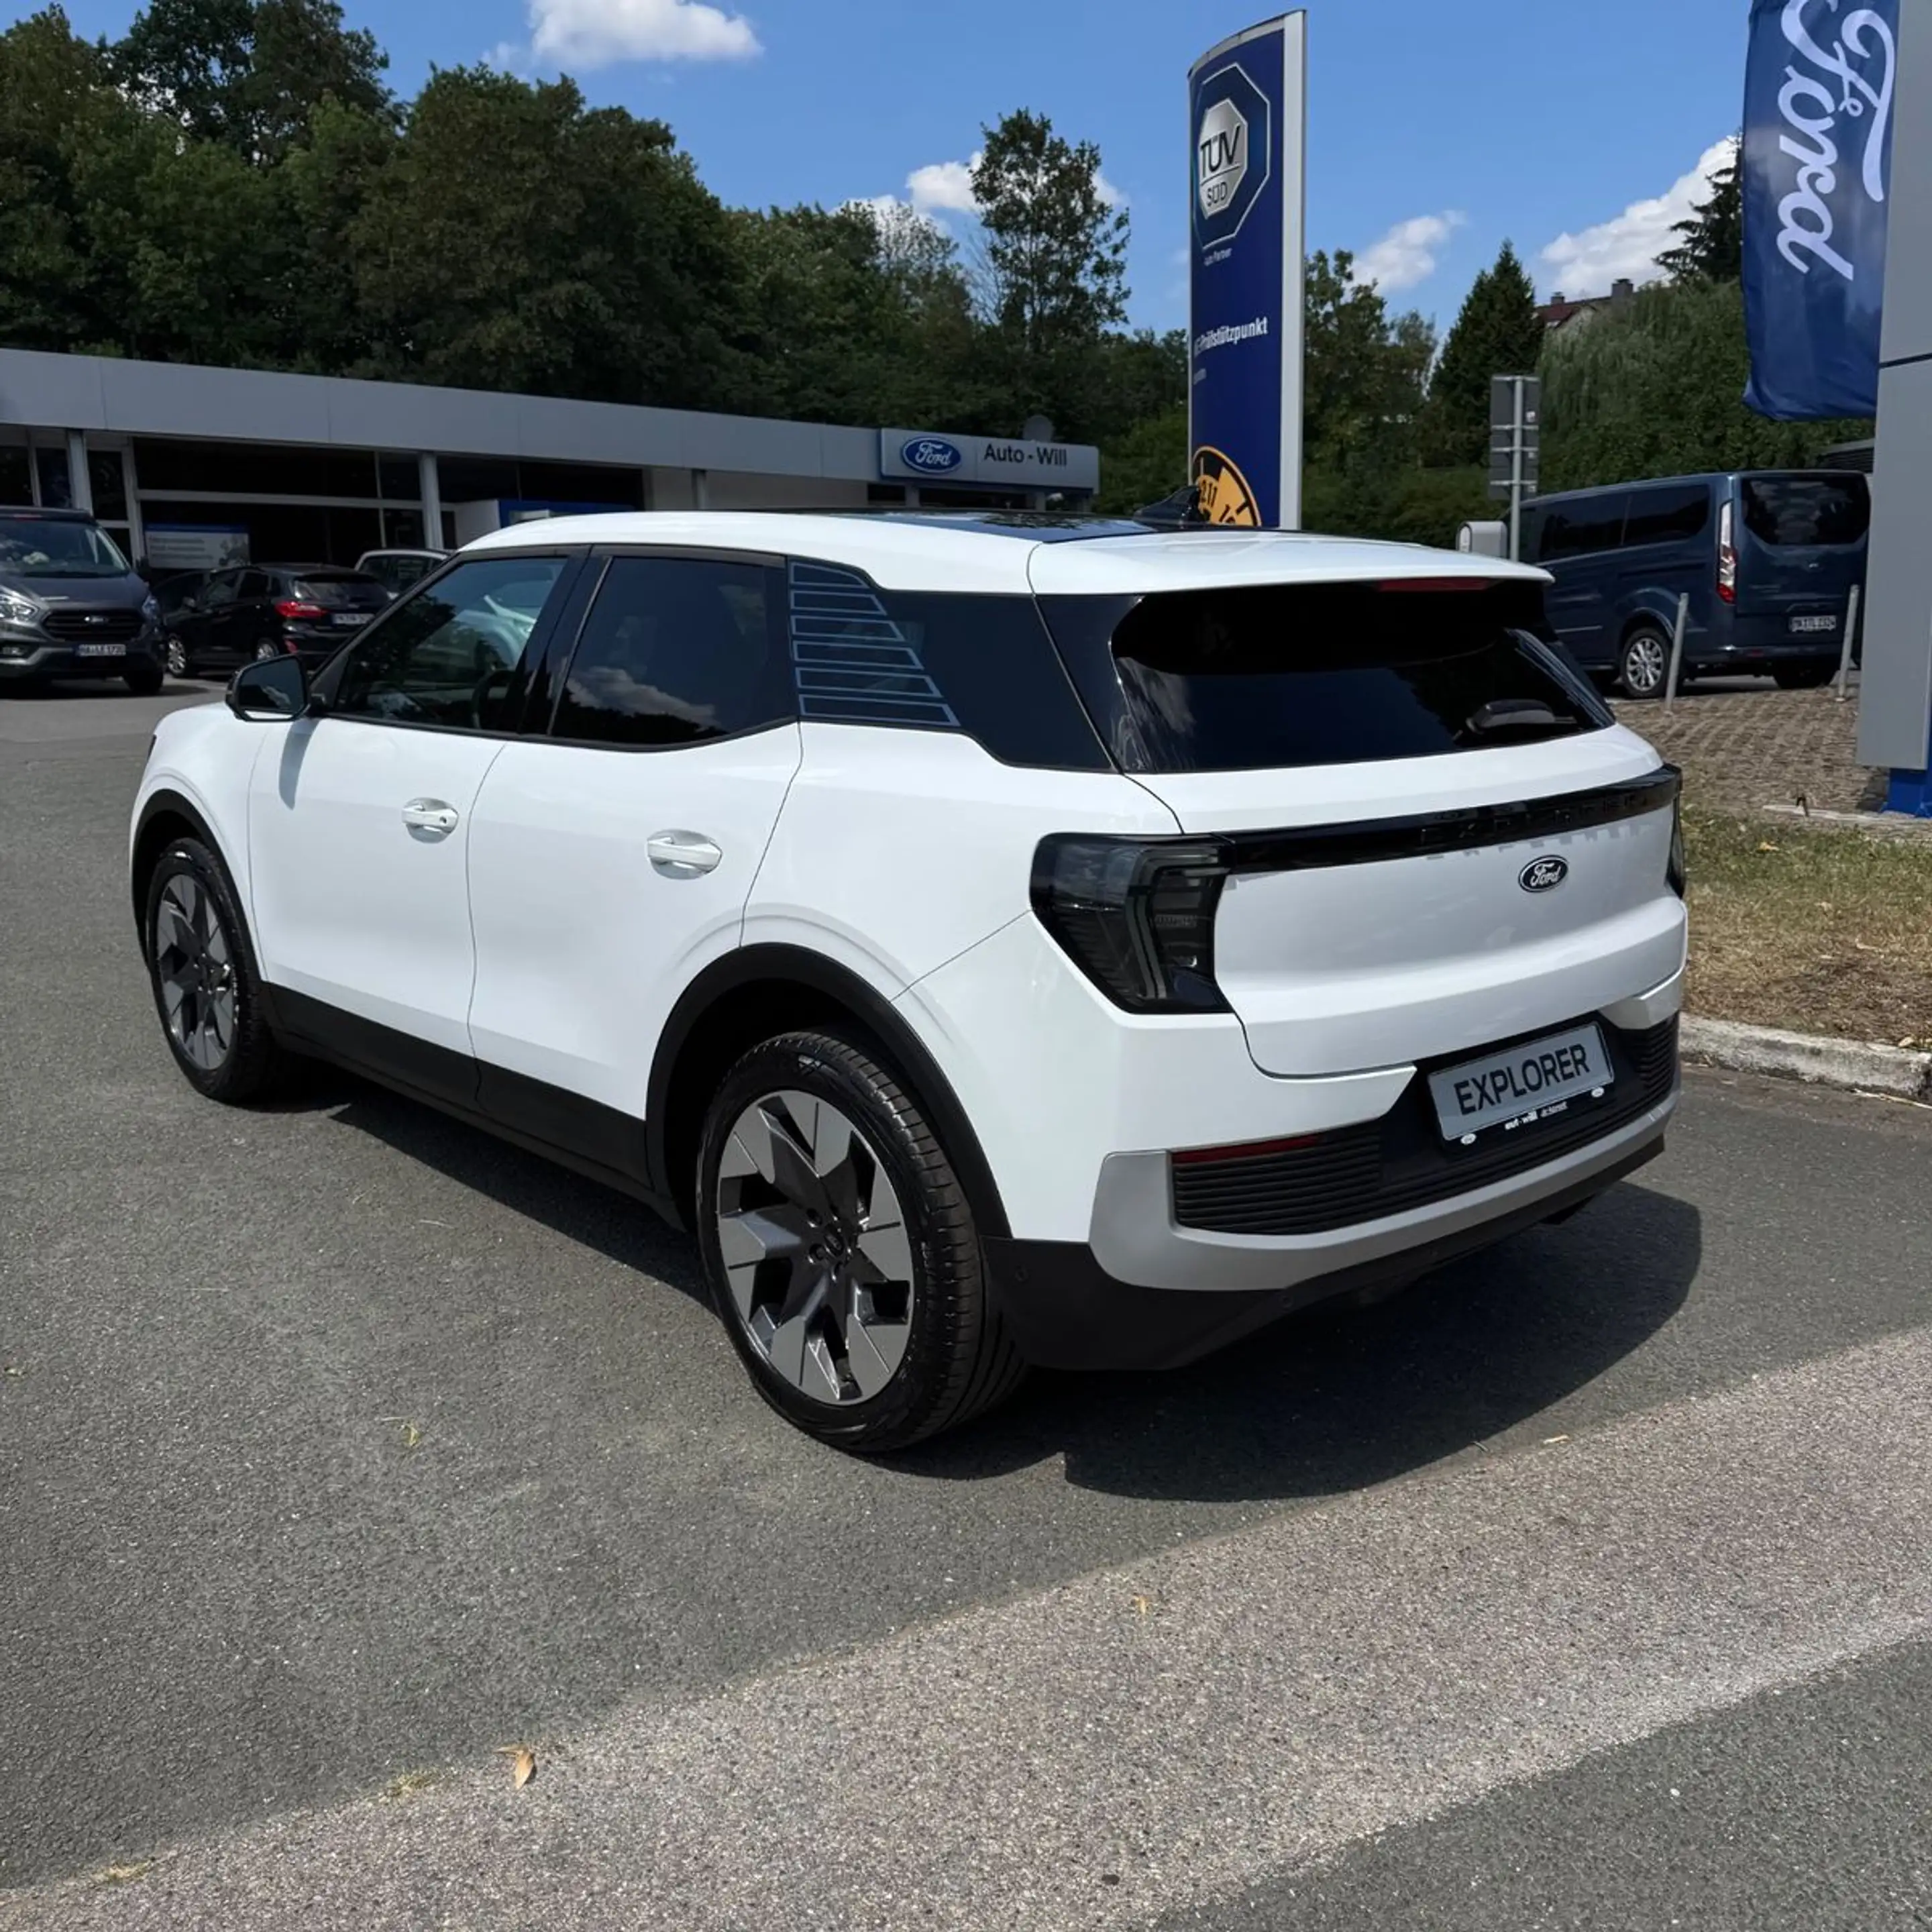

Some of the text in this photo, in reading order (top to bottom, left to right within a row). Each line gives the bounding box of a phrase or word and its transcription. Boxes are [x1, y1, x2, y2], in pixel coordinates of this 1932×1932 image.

[1199, 123, 1241, 178] TÜV
[1776, 0, 1895, 280] Ford
[1207, 181, 1228, 207] SÜD
[914, 441, 951, 466] Ford
[983, 443, 1025, 464] Auto
[1036, 447, 1067, 466] Will
[1530, 862, 1562, 887] Ford
[1453, 1042, 1591, 1116] EXPLORER
